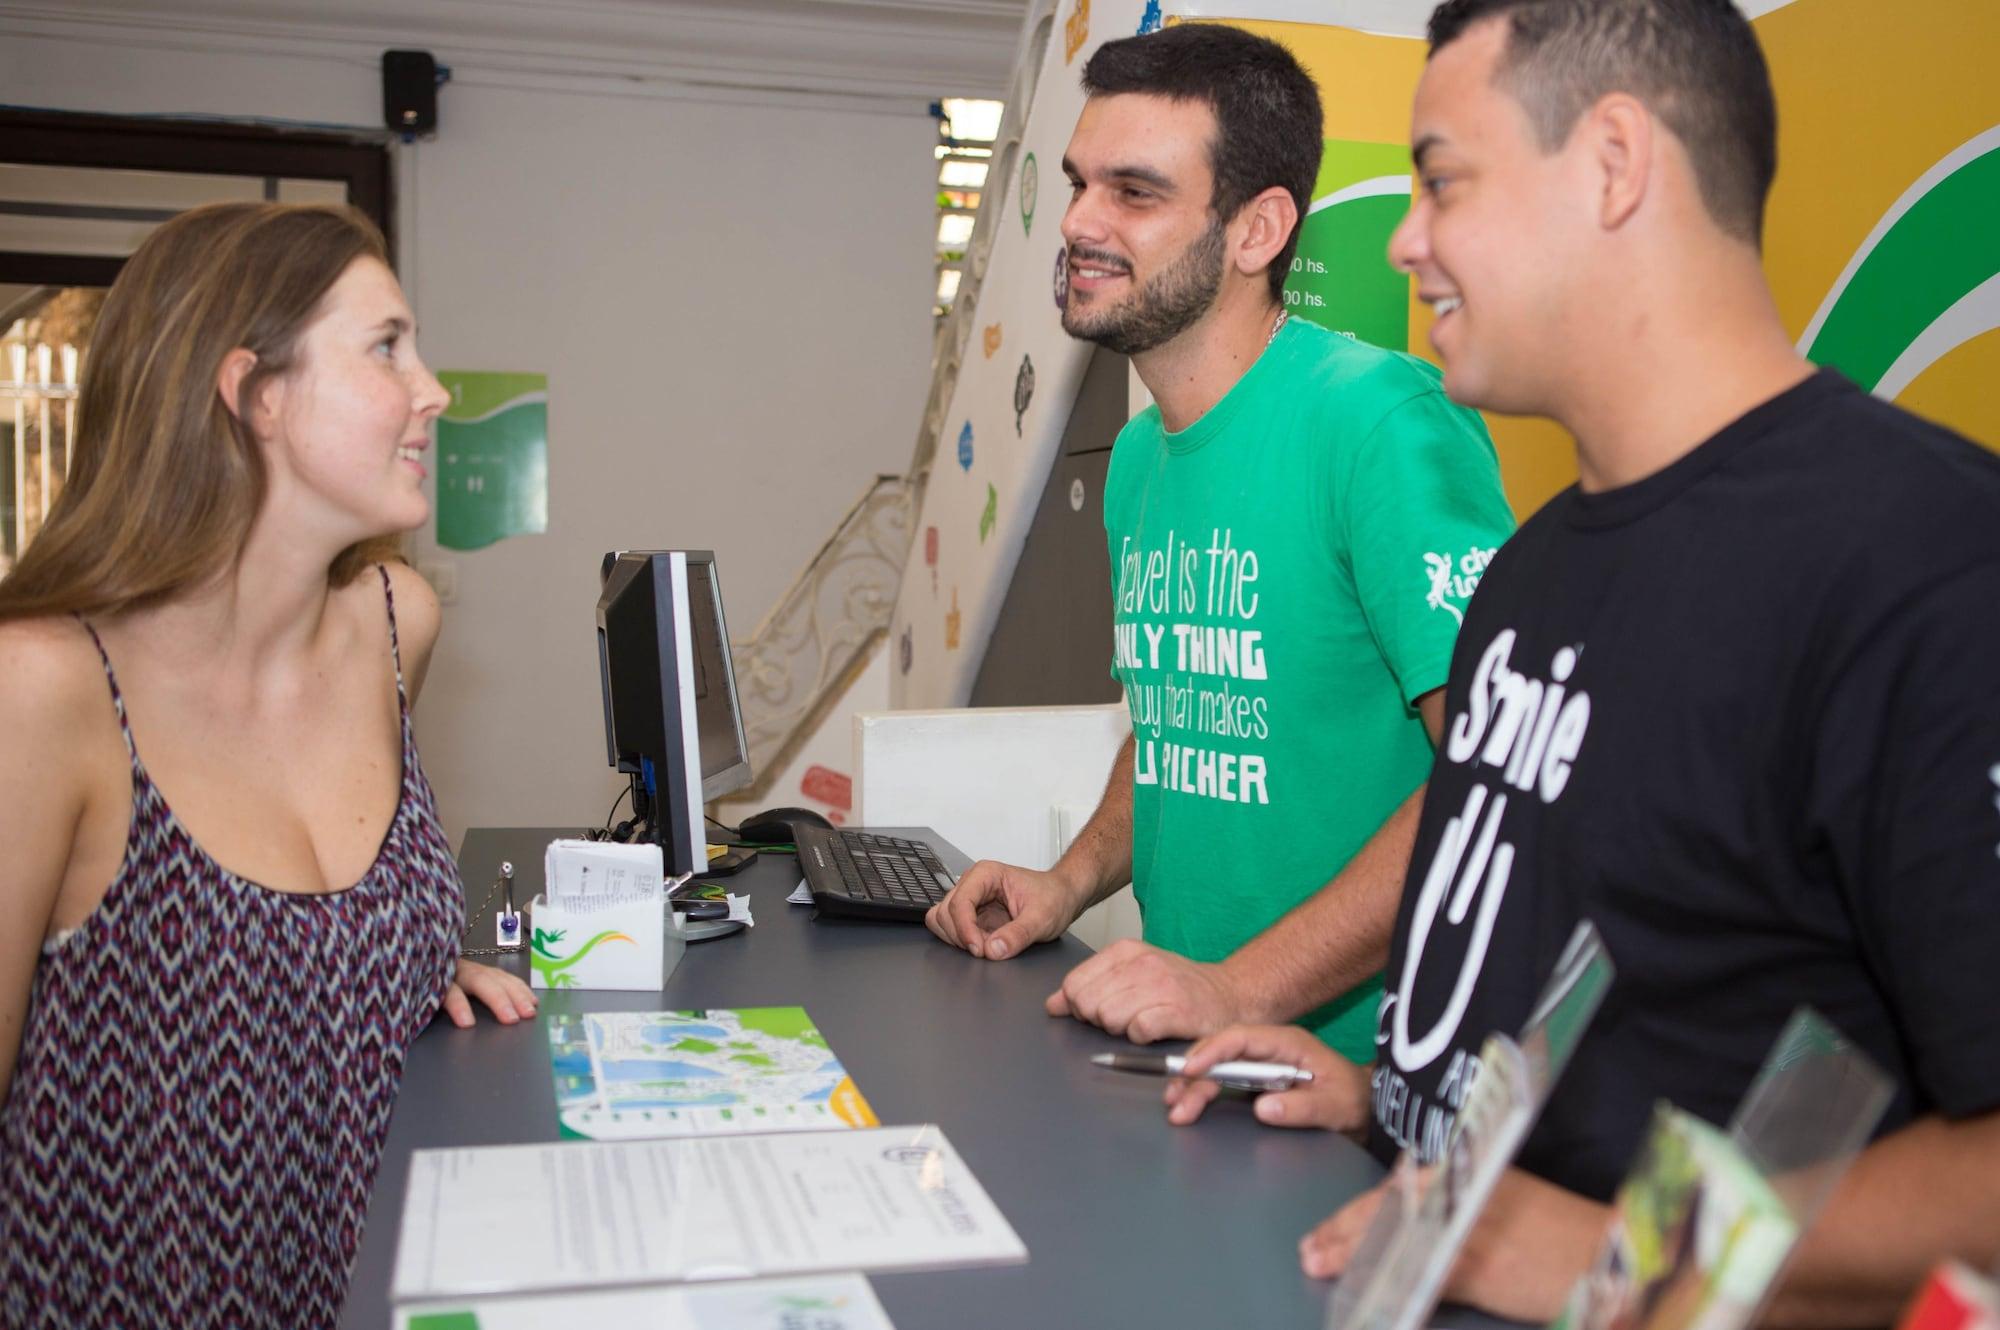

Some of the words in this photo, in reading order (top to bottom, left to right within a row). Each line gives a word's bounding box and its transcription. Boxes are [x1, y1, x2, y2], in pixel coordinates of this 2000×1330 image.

[1306, 257, 1329, 274] hs.
[1305, 291, 1327, 307] hs.
[1178, 540, 1198, 614] is
[1205, 527, 1259, 620] the
[1172, 623, 1268, 681] THING
[1165, 672, 1194, 731] that
[1198, 680, 1269, 740] makes
[1446, 627, 1592, 804] Smie
[1162, 741, 1270, 805] RICHER
